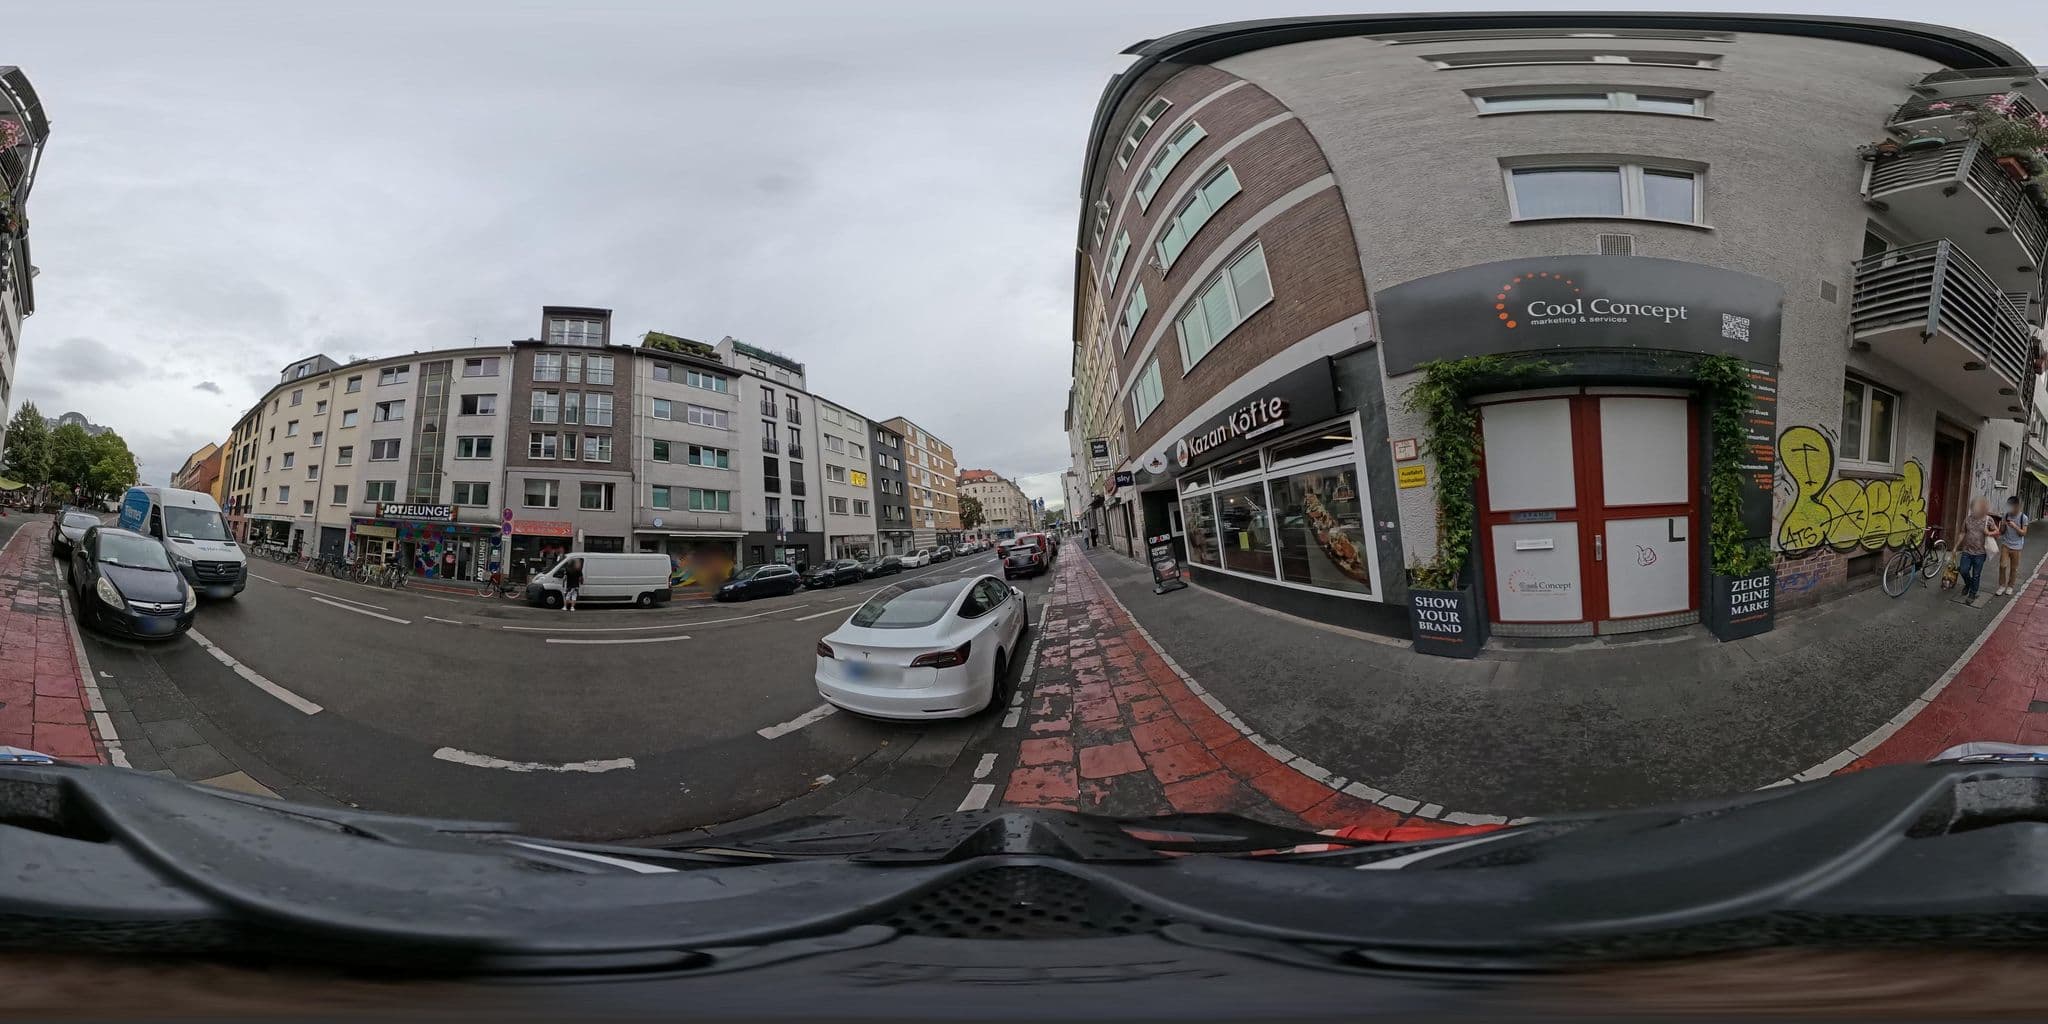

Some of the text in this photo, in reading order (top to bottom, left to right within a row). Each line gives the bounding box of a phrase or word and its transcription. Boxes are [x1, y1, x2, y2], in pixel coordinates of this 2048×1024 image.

[1527, 298, 1688, 323] Cool Concept
[1531, 316, 1577, 325] marketing
[1188, 397, 1283, 458] Kazan Köfte
[1116, 474, 1131, 483] sky
[384, 505, 449, 517] JOTJELUNGE
[1539, 581, 1572, 591] Concept
[1731, 575, 1770, 592] ZEIGE
[1415, 596, 1458, 609] SHOW
[1731, 588, 1770, 605] DEINE
[1731, 600, 1770, 616] MARKE
[1417, 609, 1461, 623] YOUR
[1418, 621, 1462, 634] BRAND
